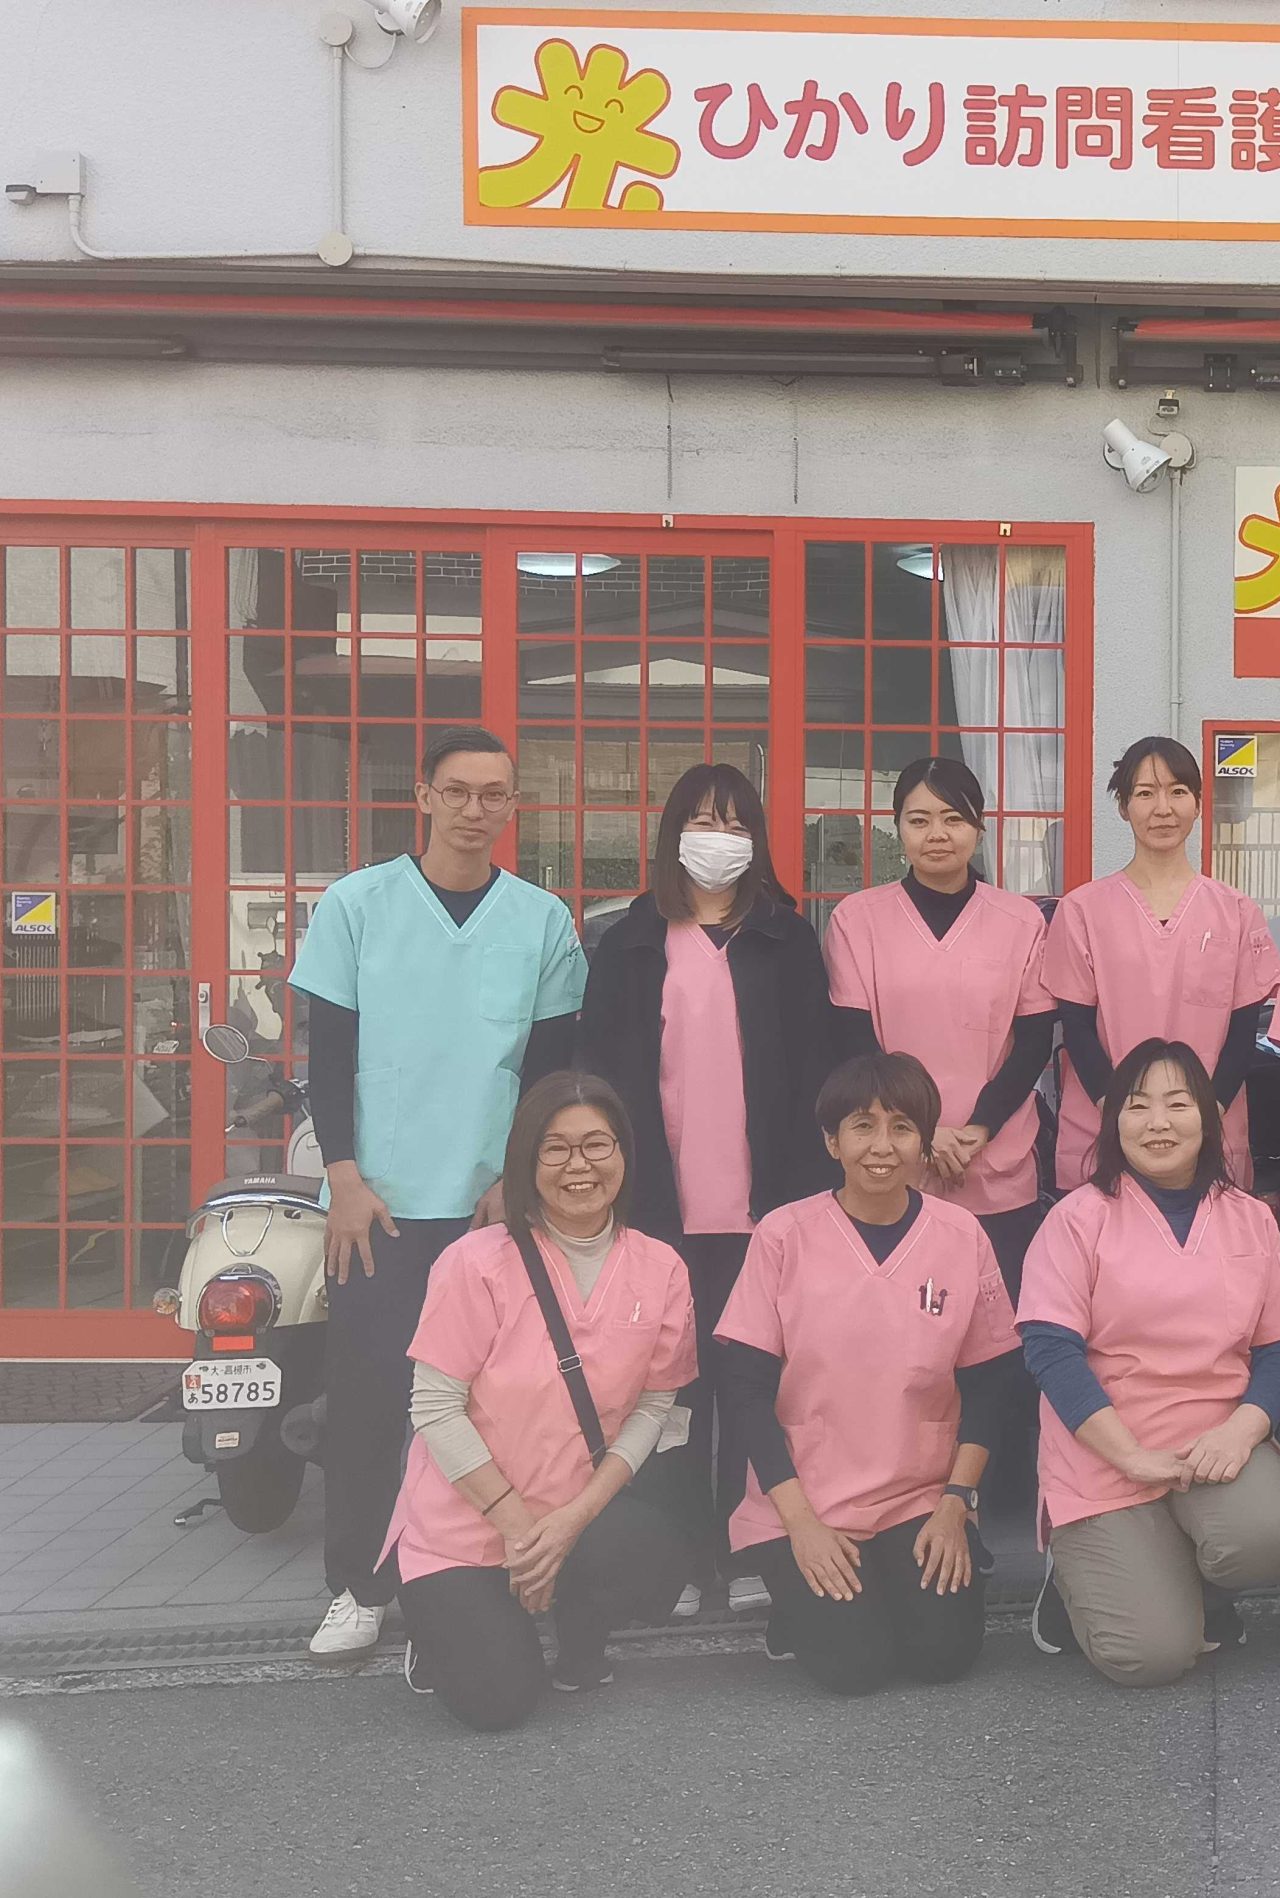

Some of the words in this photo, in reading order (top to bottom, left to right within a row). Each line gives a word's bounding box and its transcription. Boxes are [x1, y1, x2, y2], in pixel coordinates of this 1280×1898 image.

[1218, 767, 1254, 775] ALSOK
[15, 924, 52, 933] ALSOK
[243, 1176, 277, 1185] YAMAHA
[201, 1381, 276, 1404] 58785
